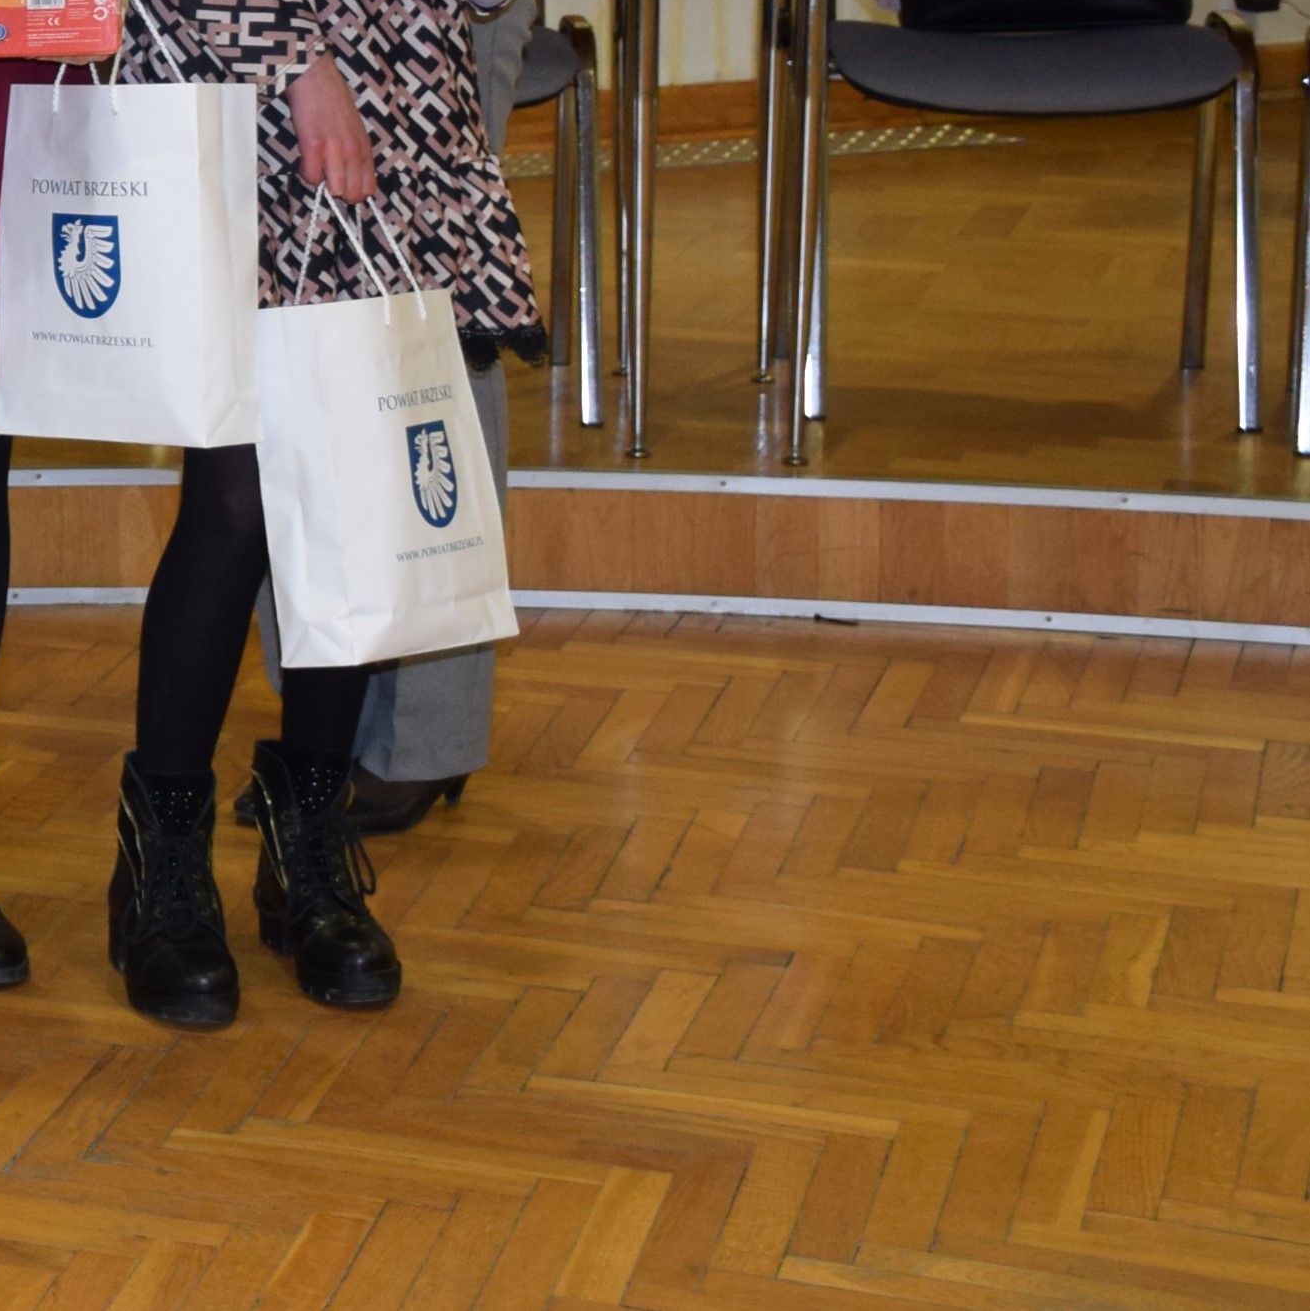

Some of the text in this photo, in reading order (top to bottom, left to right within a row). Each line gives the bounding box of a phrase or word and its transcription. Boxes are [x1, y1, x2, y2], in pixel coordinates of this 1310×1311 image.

[32, 179, 148, 197] POWIAT BRZESKI
[377, 391, 419, 411] POWIAT
